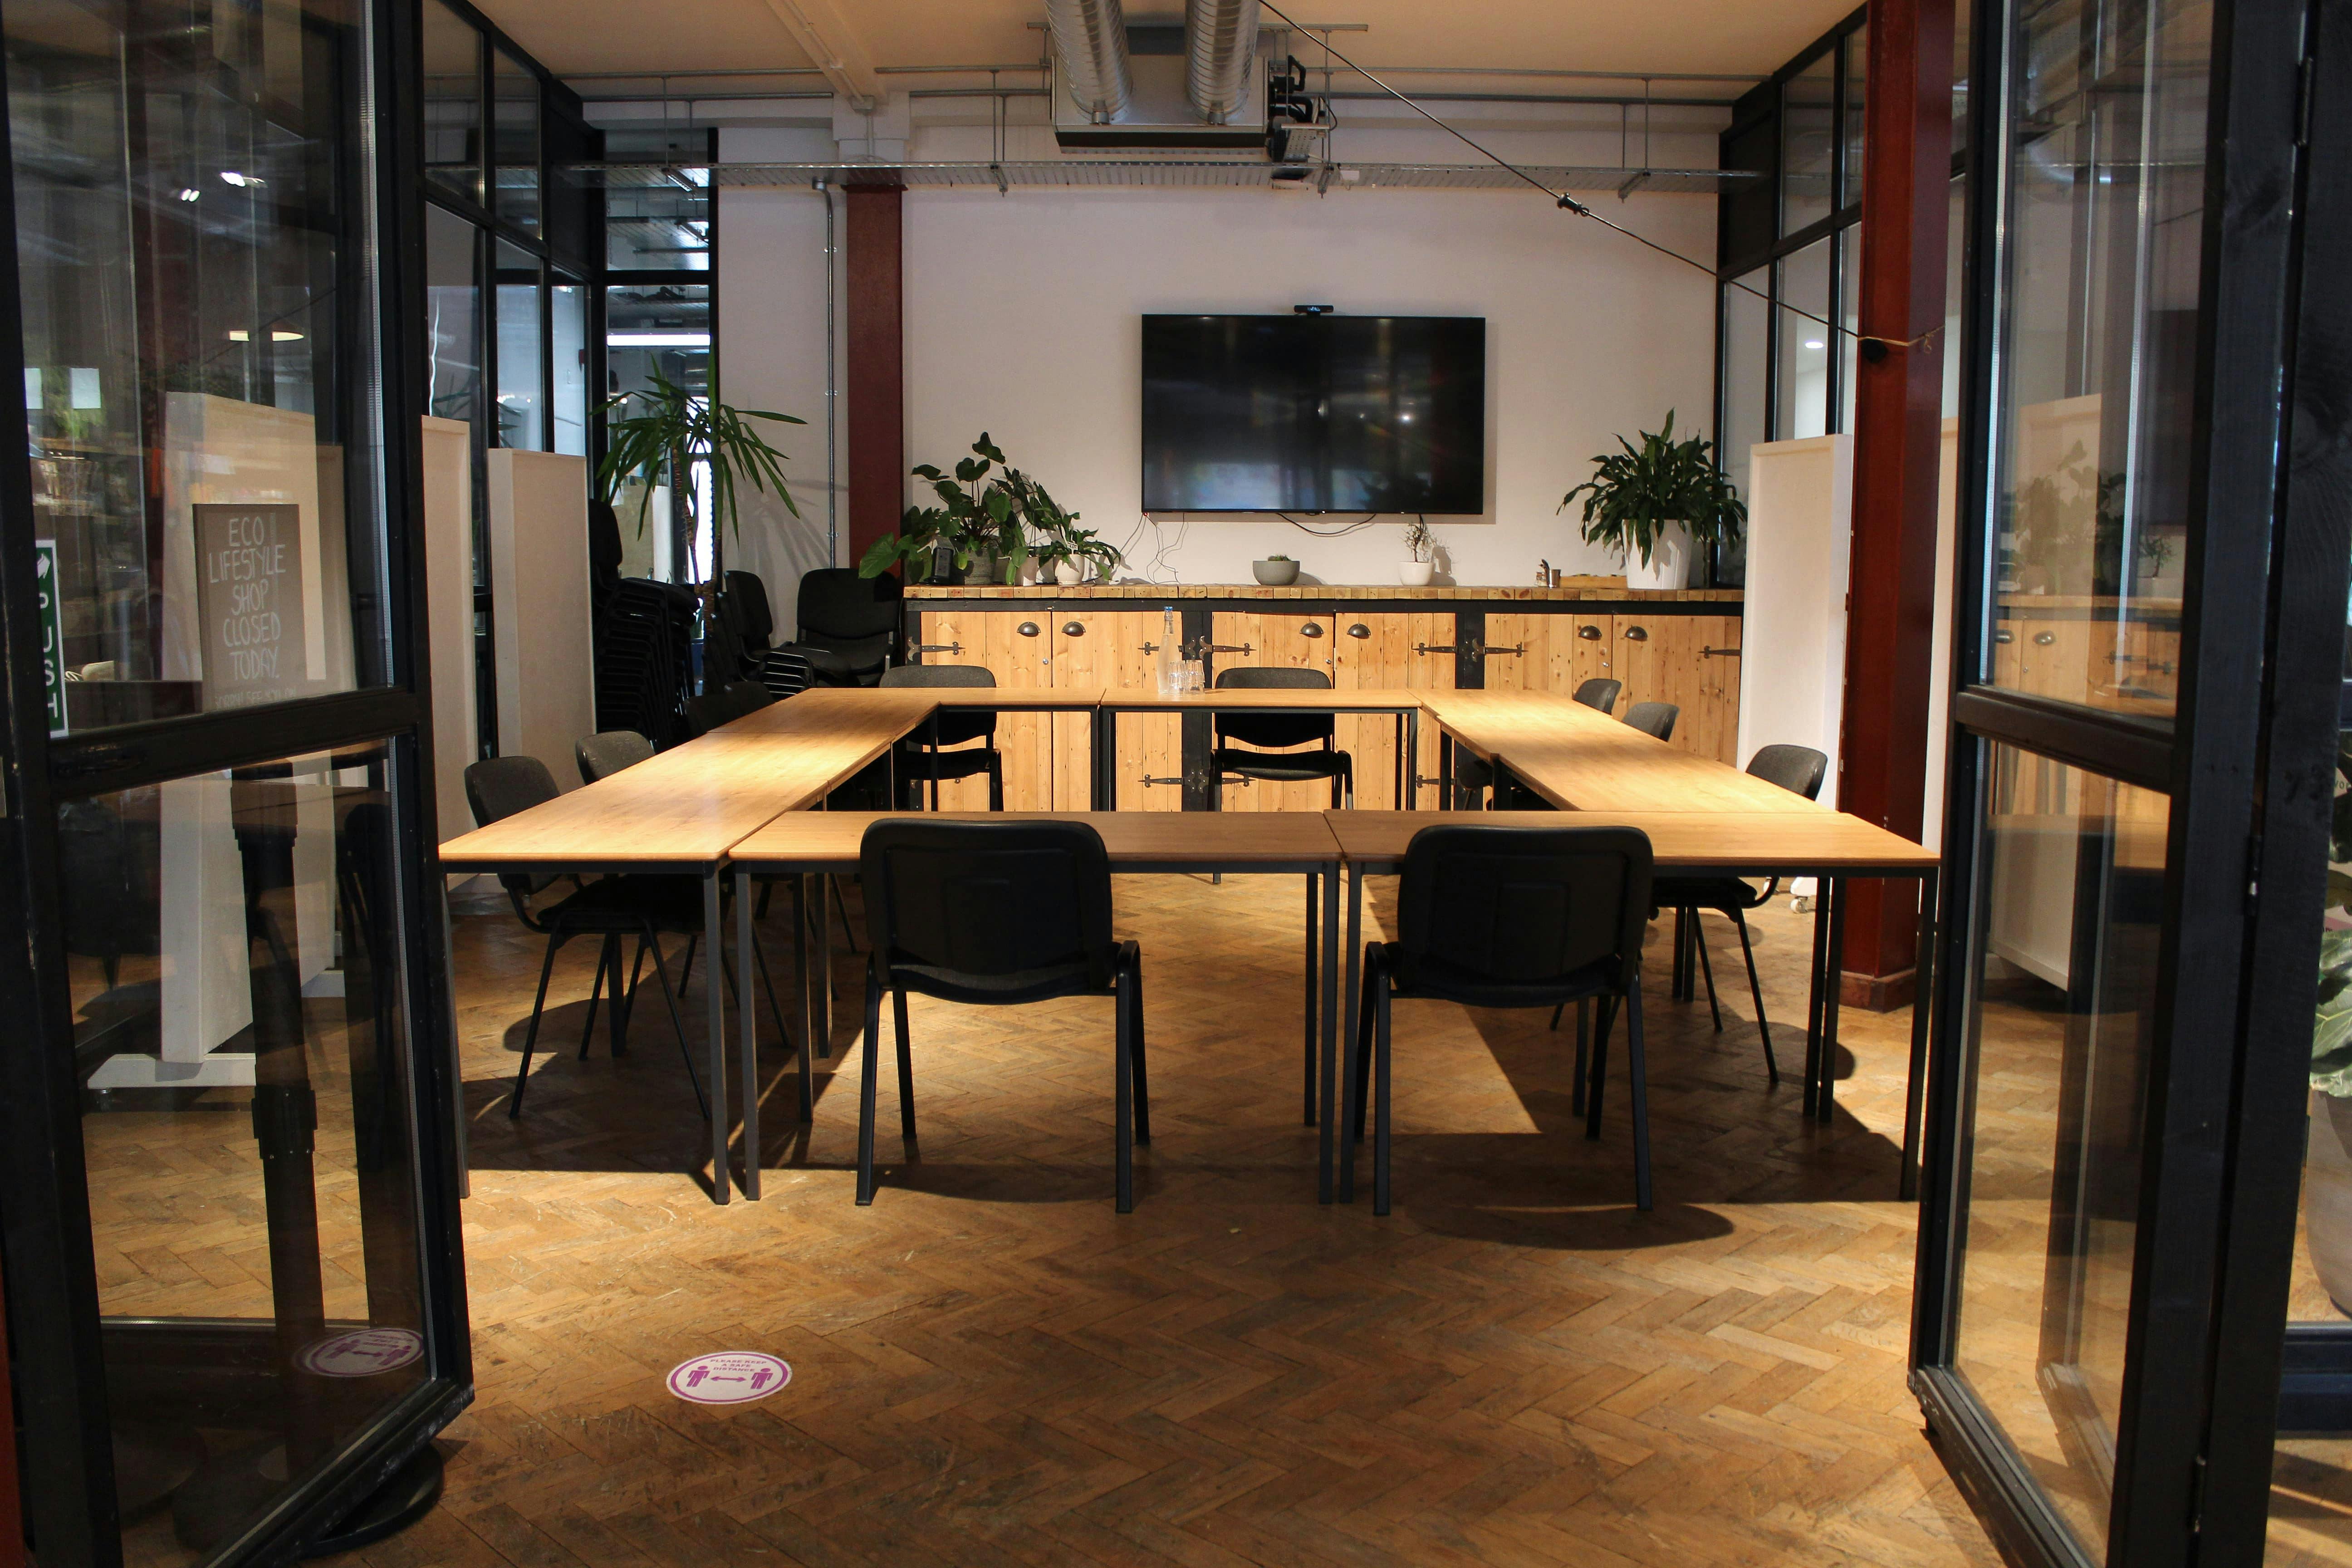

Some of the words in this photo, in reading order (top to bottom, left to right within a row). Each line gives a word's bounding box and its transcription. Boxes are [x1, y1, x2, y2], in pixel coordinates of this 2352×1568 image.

[229, 516, 265, 547] ECO
[209, 544, 286, 583] LIFESTYLE
[231, 578, 269, 616] SHOP
[223, 612, 281, 647] CLOSED
